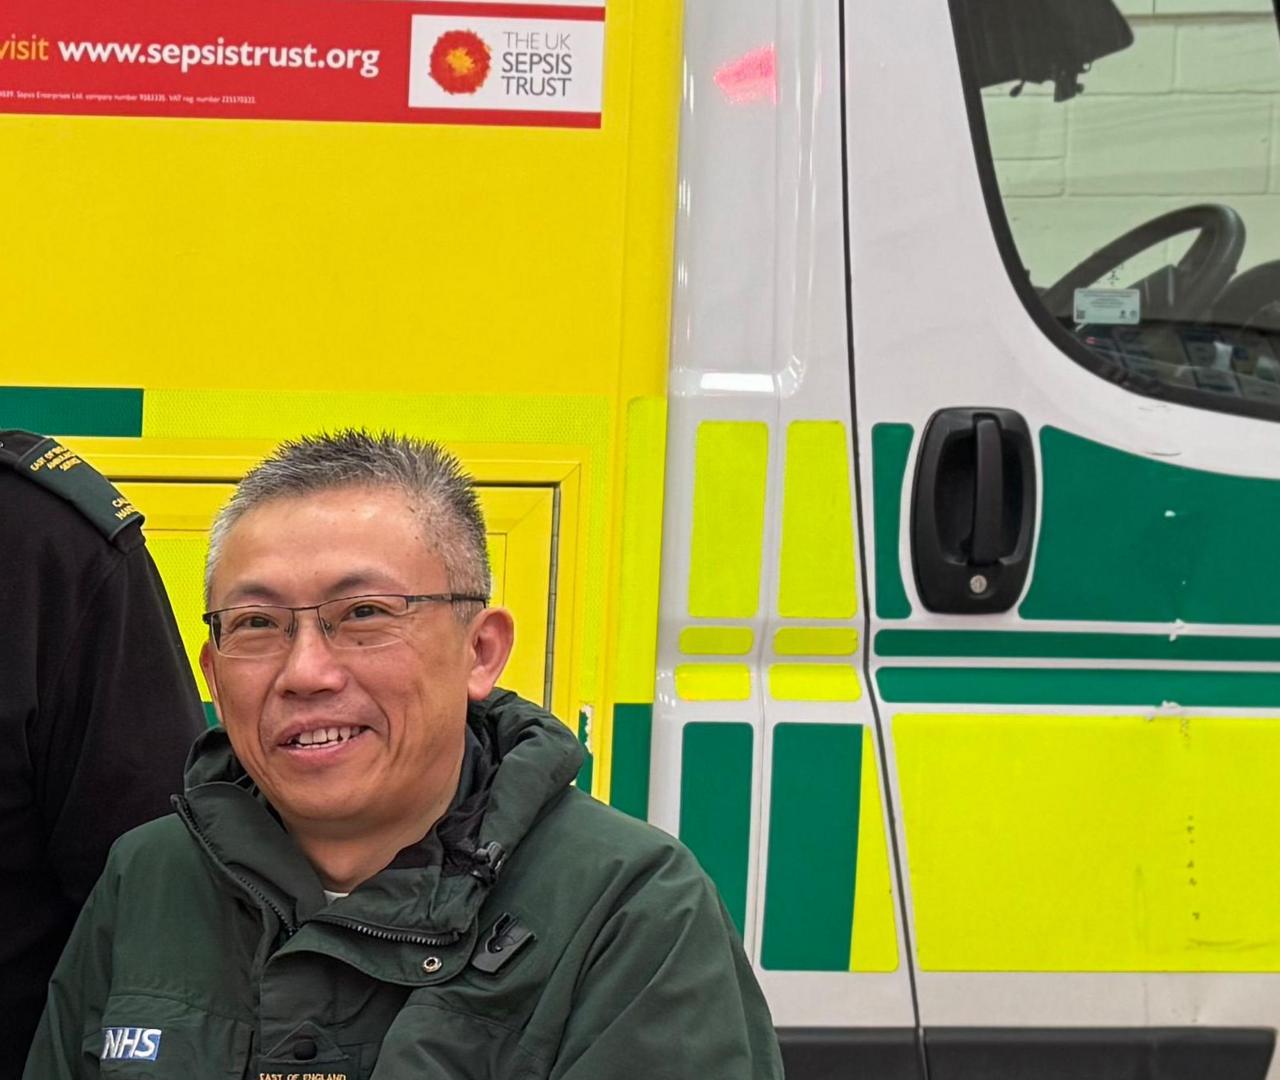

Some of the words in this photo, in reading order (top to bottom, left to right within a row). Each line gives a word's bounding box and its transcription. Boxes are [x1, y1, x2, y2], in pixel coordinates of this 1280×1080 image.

[503, 32, 540, 50] THE
[545, 33, 572, 51] UK
[57, 37, 380, 78] www.sepsistrust.org
[501, 52, 573, 75] SEPSIS
[500, 76, 573, 97] TRUST
[101, 1028, 162, 1059] NHS
